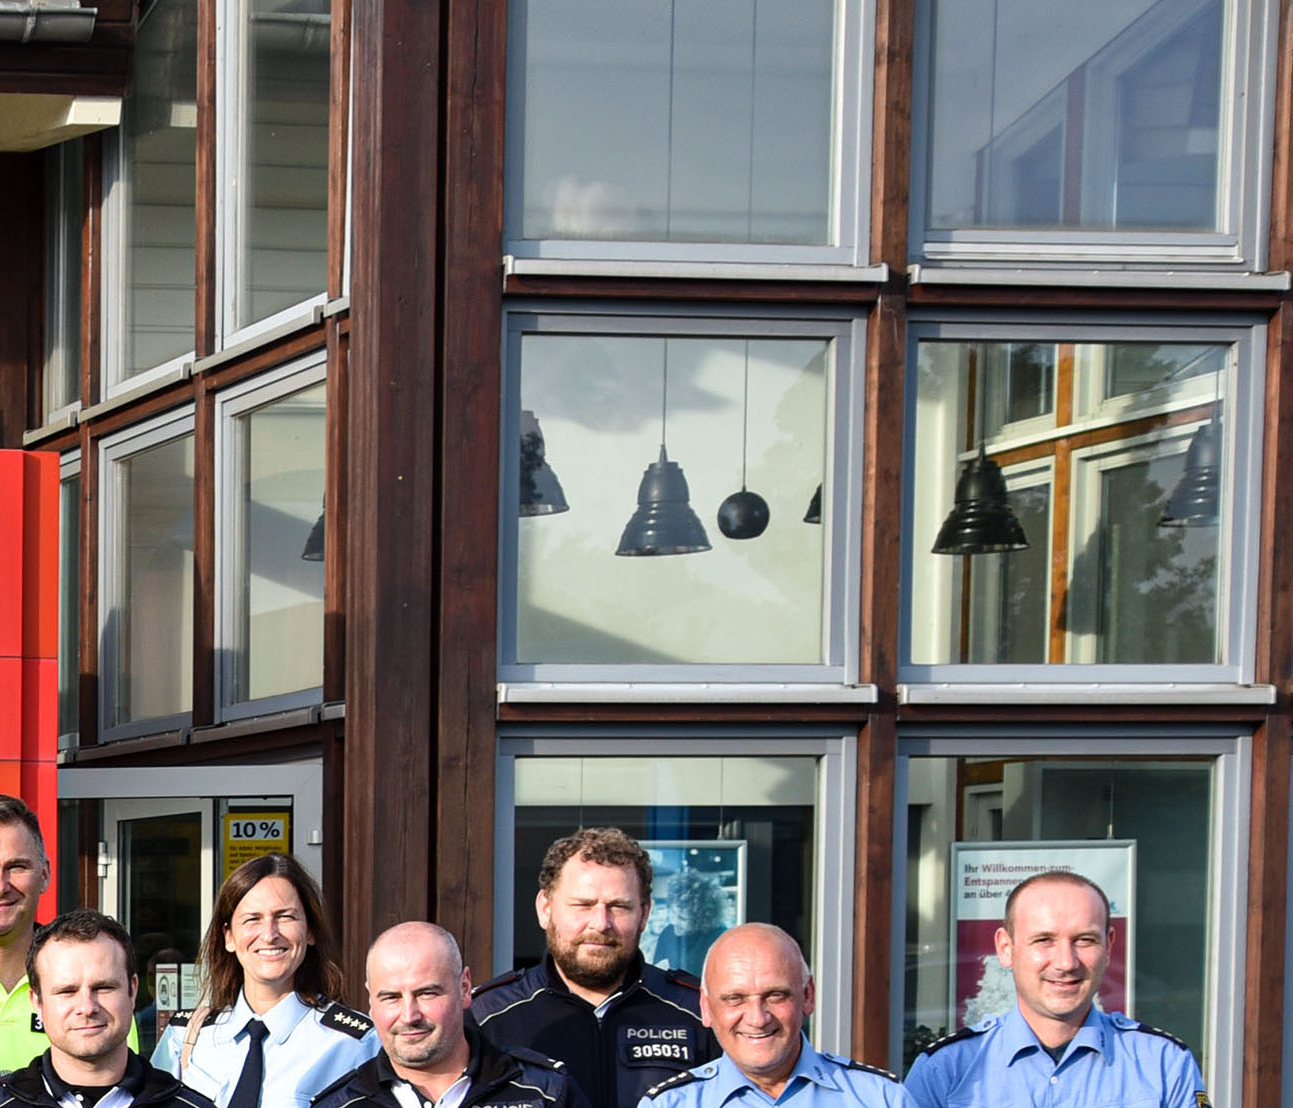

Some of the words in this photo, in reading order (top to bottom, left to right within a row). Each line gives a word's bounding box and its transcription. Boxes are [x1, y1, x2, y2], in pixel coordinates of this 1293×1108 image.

[964, 864, 978, 873] Ihr
[979, 889, 1002, 899] über
[627, 1028, 688, 1041] POLICIE
[632, 1043, 689, 1060] 305031
